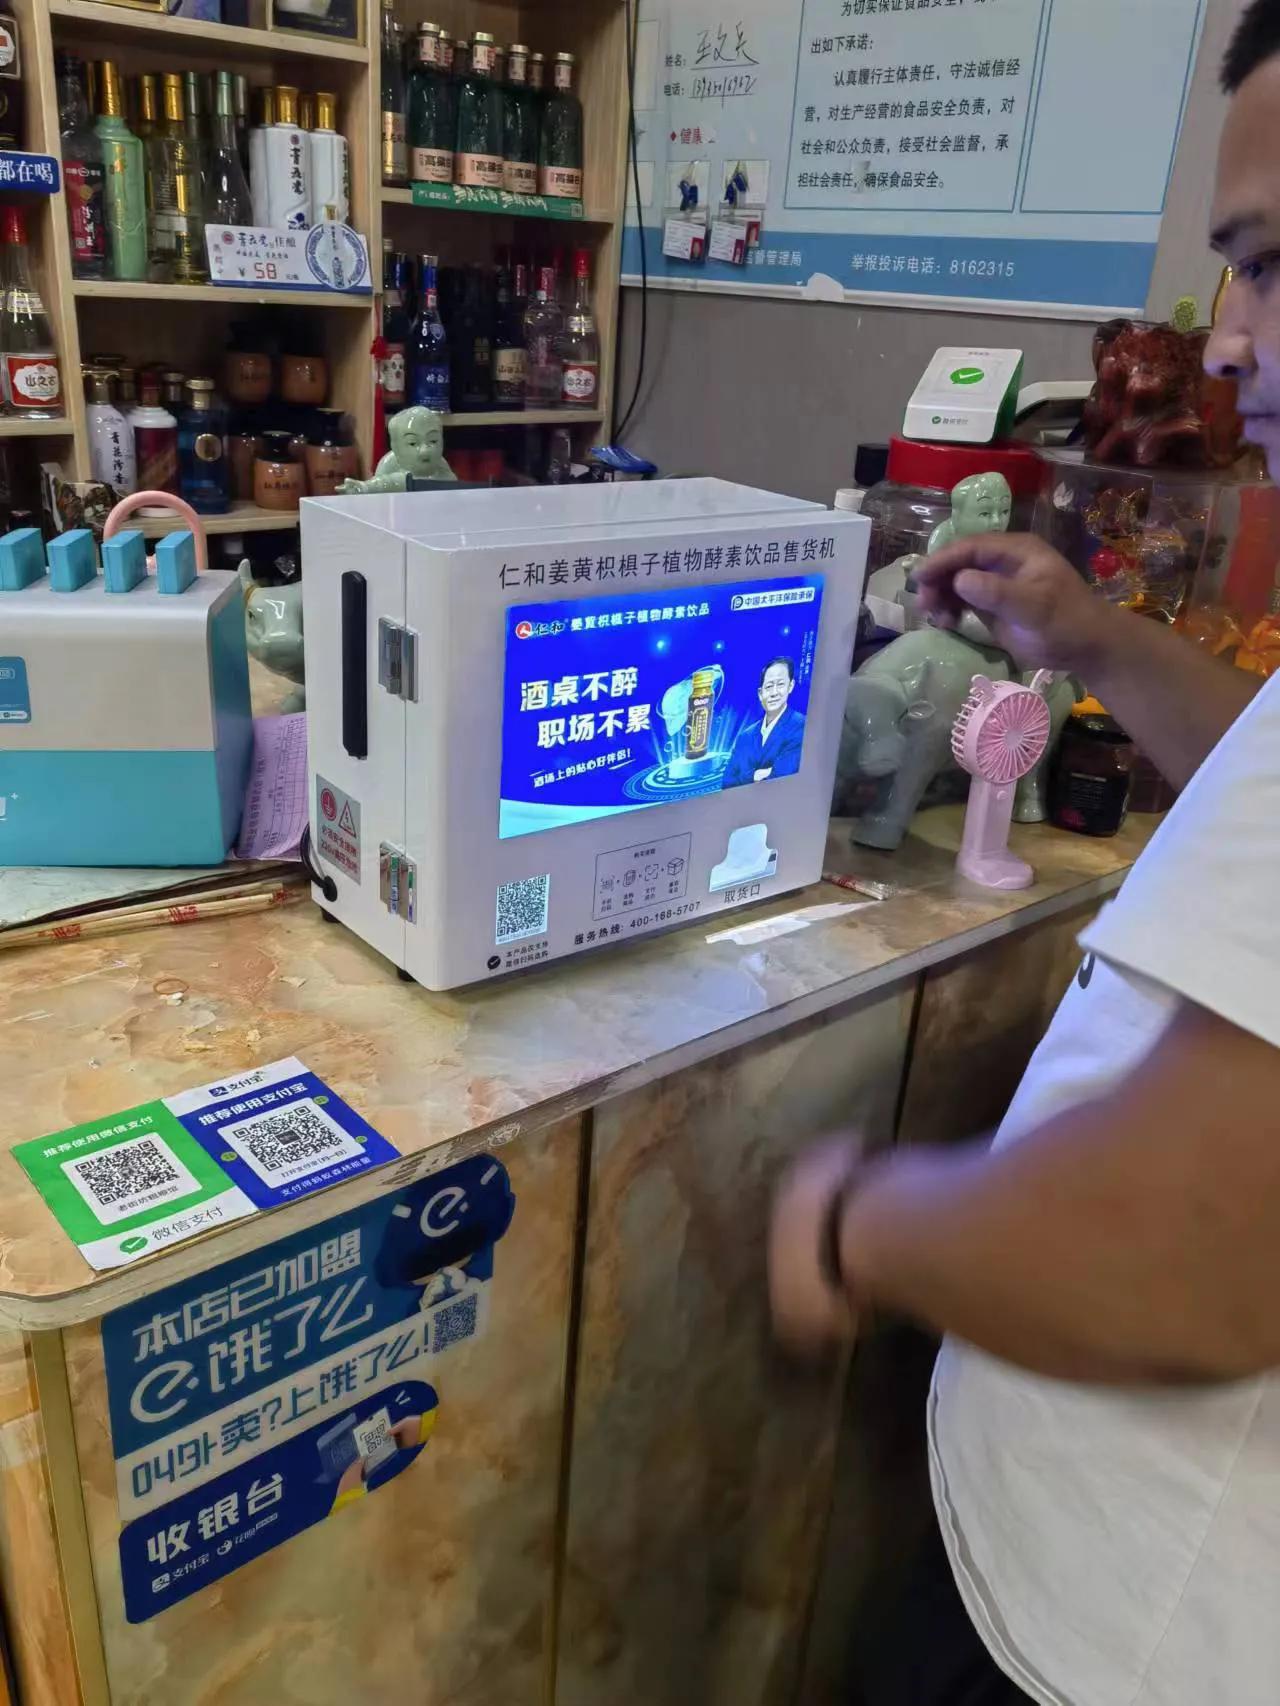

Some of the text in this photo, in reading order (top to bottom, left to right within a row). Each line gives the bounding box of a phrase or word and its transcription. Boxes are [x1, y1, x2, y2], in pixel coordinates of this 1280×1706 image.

[254, 262, 277, 280] 58
[520, 667, 638, 712] 酒桌不醉
[537, 703, 652, 750] 职场不累
[723, 884, 761, 904] 取货口
[198, 1082, 309, 1126] 推荐使用支付宝
[228, 1073, 264, 1091] 支付宝
[42, 1115, 154, 1158] 推荐使用微信支付
[151, 1206, 224, 1241] 微信支付
[132, 1227, 362, 1364] 本店已加盟
[207, 1275, 374, 1394] 饿了么
[147, 1472, 284, 1565] 收银台
